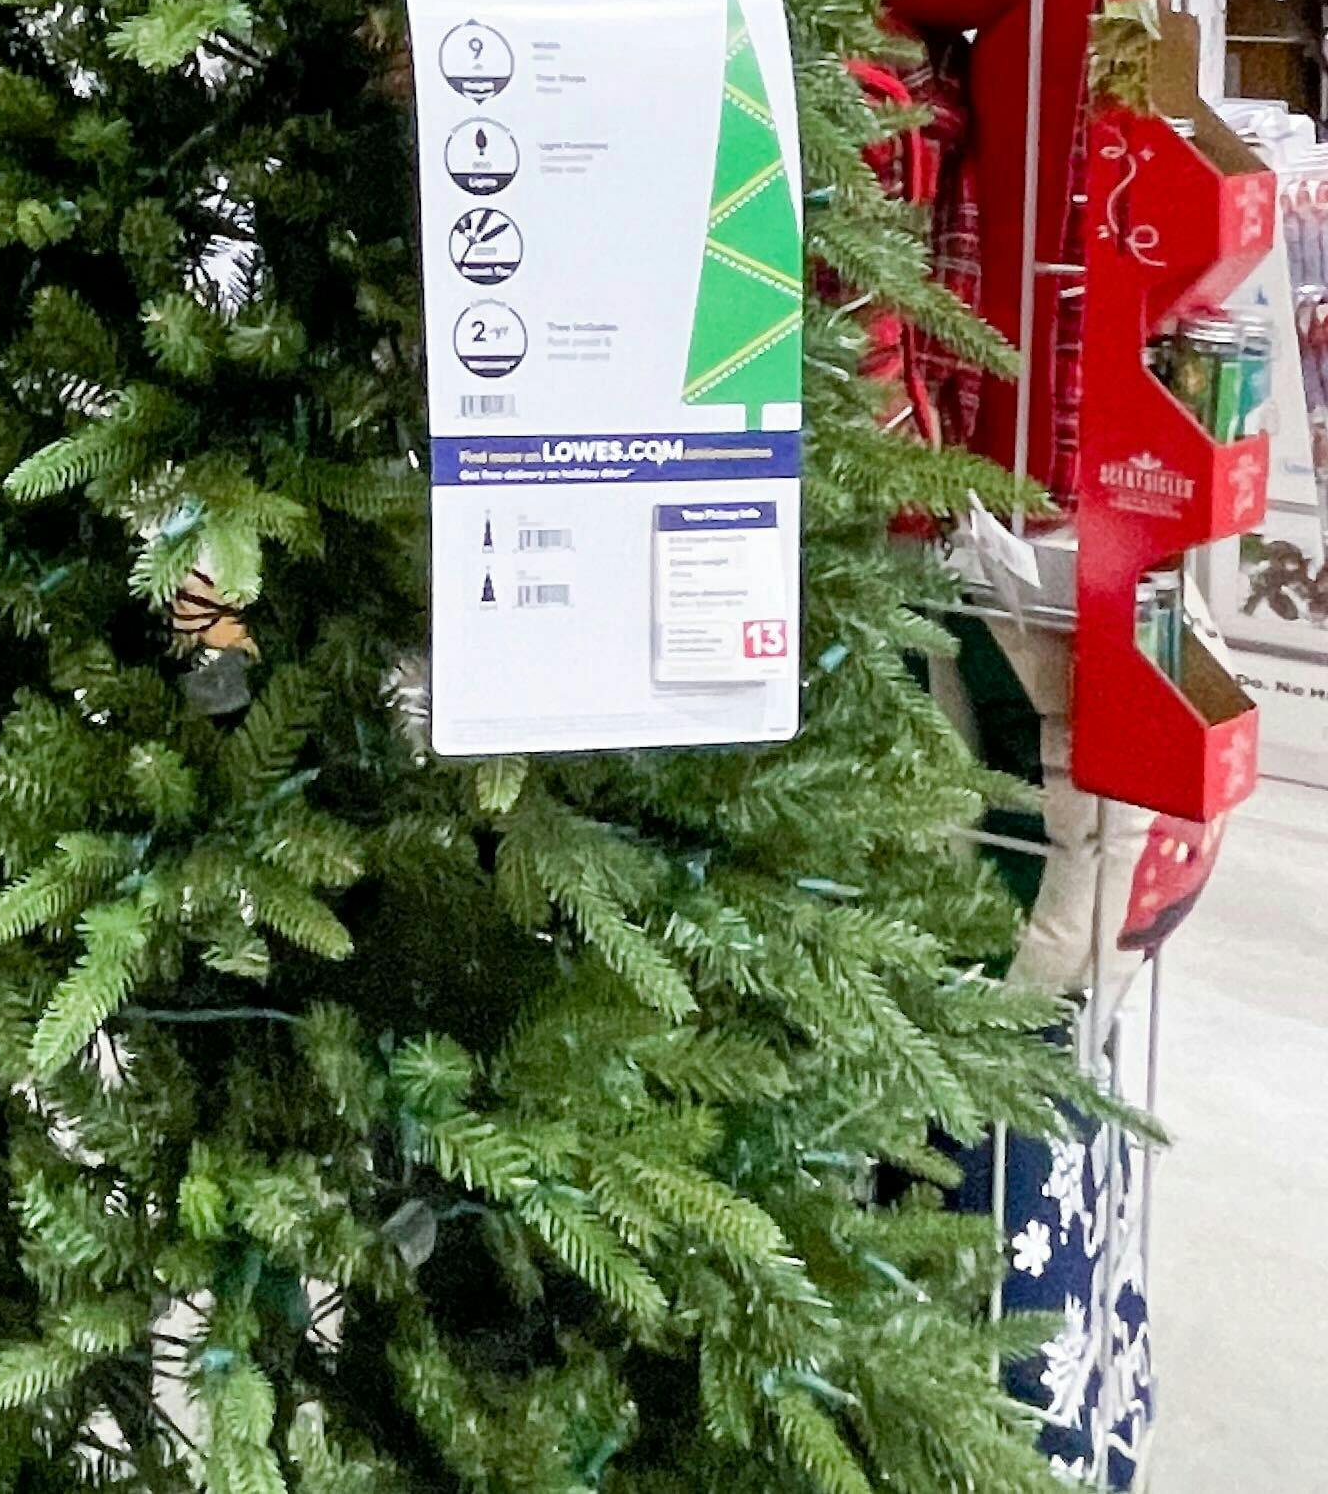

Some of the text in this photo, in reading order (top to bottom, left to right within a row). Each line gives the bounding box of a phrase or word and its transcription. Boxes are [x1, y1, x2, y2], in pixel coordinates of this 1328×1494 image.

[468, 37, 484, 60] 9
[543, 439, 684, 463] LOWES.COM
[746, 621, 784, 655] 13
